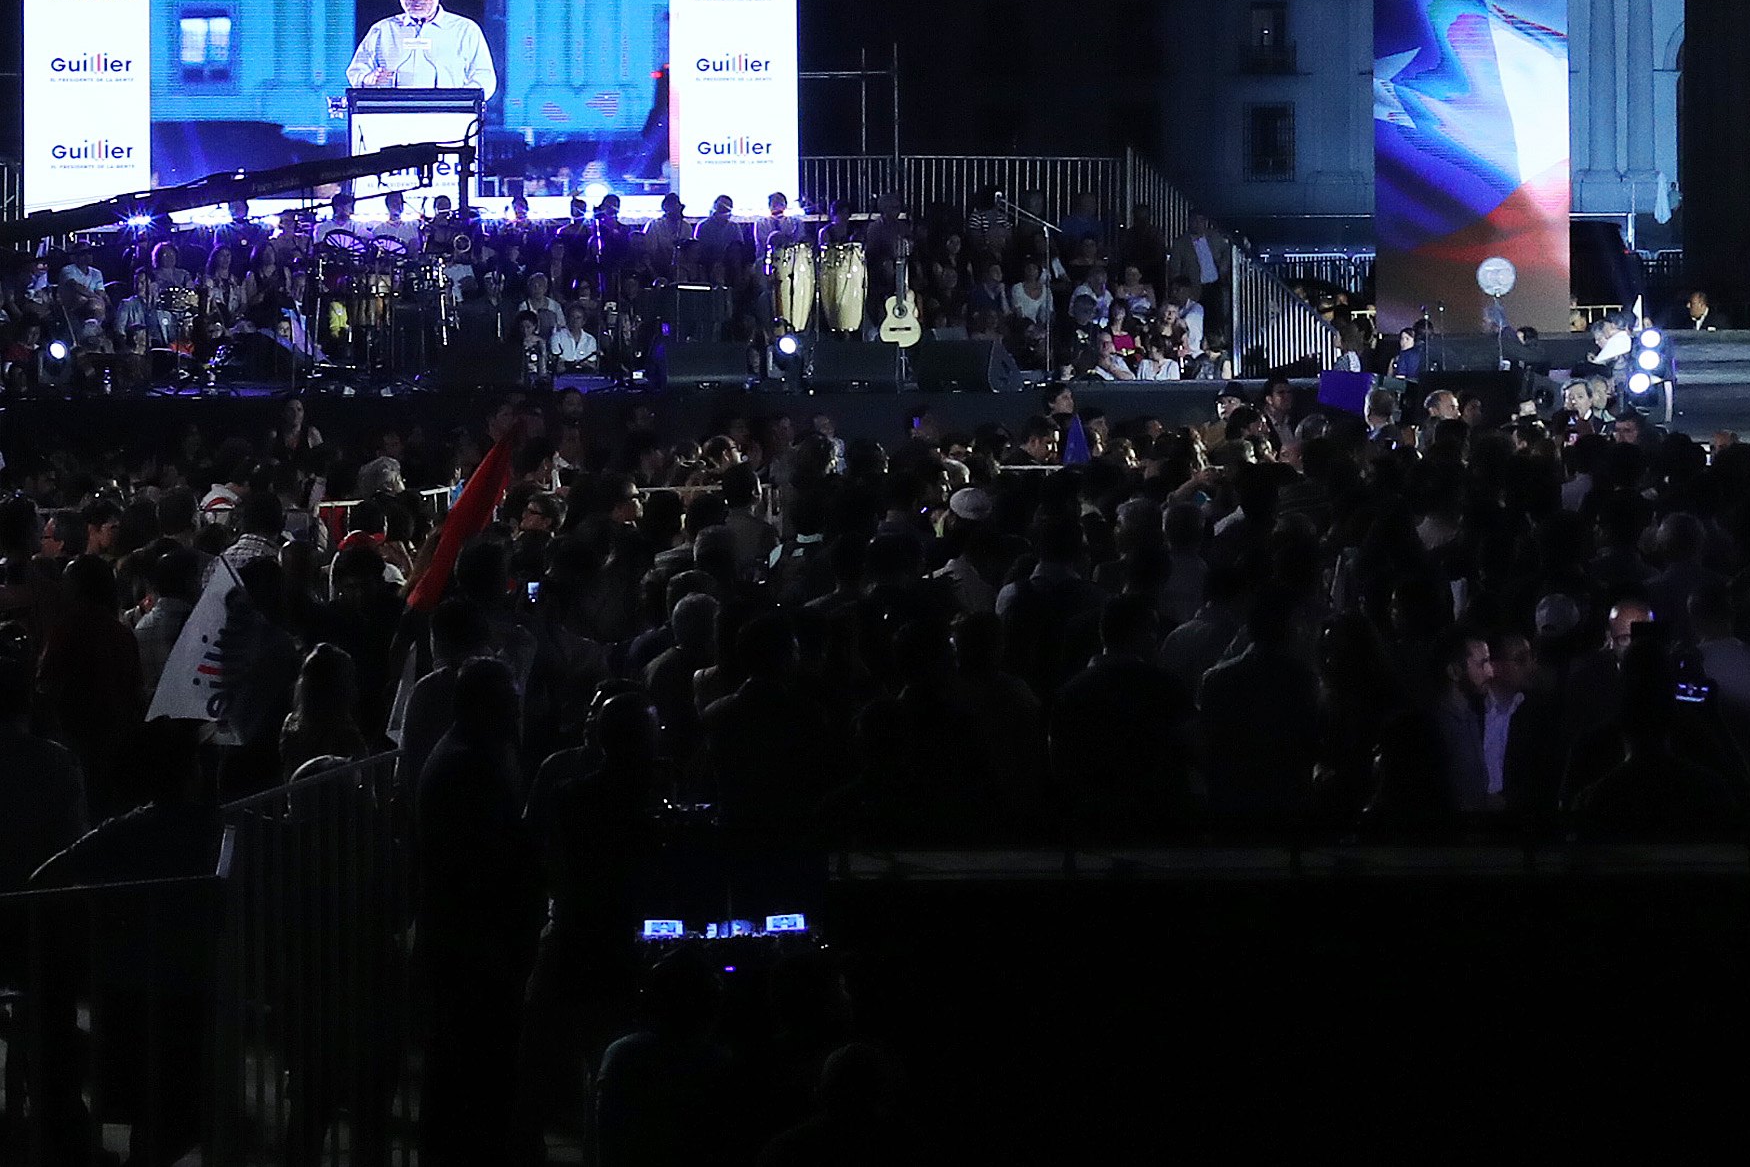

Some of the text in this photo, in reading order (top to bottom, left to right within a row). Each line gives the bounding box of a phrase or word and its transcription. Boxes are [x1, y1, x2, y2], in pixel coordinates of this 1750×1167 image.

[51, 52, 132, 75] Guillier
[696, 52, 771, 75] Guillier
[52, 138, 133, 162] Guillier
[697, 135, 772, 158] Guillier
